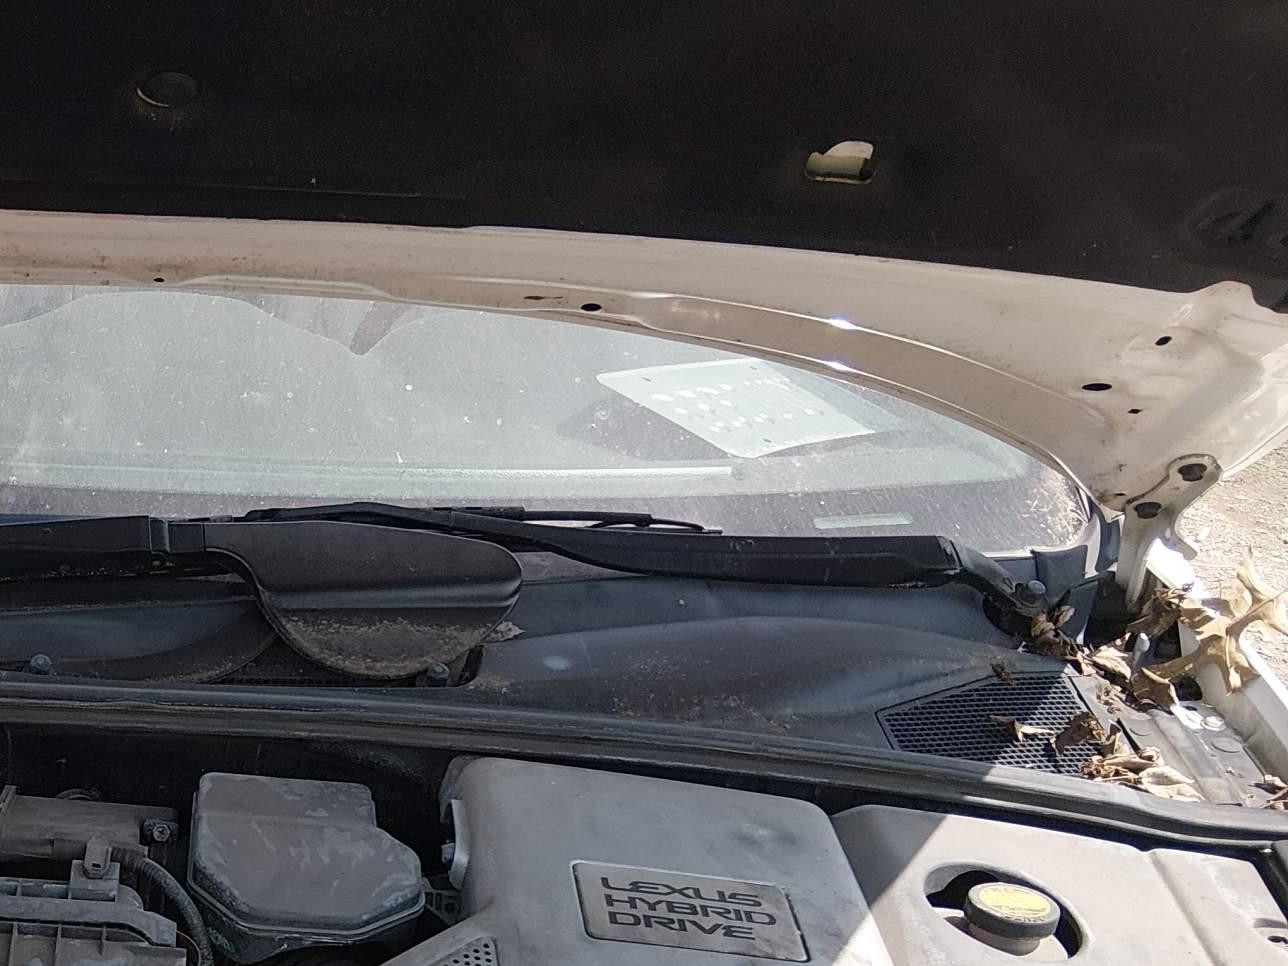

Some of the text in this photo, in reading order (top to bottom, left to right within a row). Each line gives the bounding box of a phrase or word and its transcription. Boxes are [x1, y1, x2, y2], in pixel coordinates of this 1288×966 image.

[600, 877, 763, 908] LEXUS
[604, 893, 777, 926] HYBRID
[607, 910, 756, 941] DRIVE
